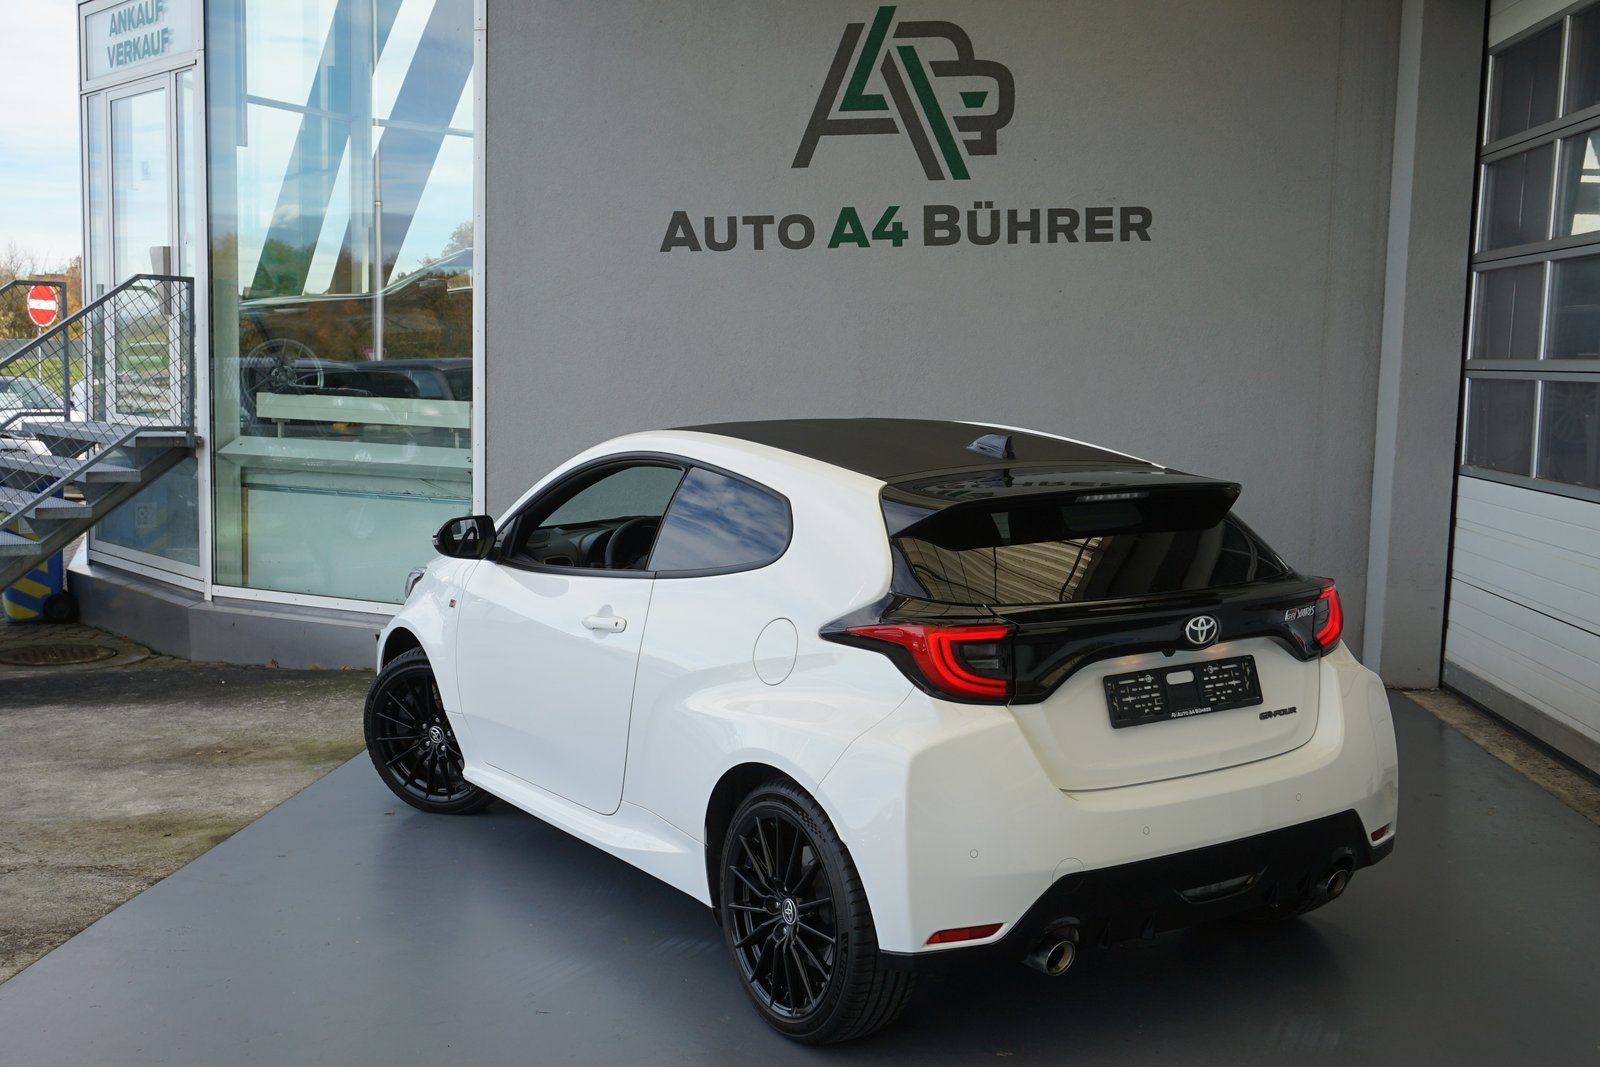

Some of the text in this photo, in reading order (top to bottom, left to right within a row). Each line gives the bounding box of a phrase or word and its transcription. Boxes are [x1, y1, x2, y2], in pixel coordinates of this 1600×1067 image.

[109, 0, 164, 37] ANKAUF
[107, 27, 169, 68] VERKAUF
[660, 201, 1153, 252] AUTO A4 BÜHRER
